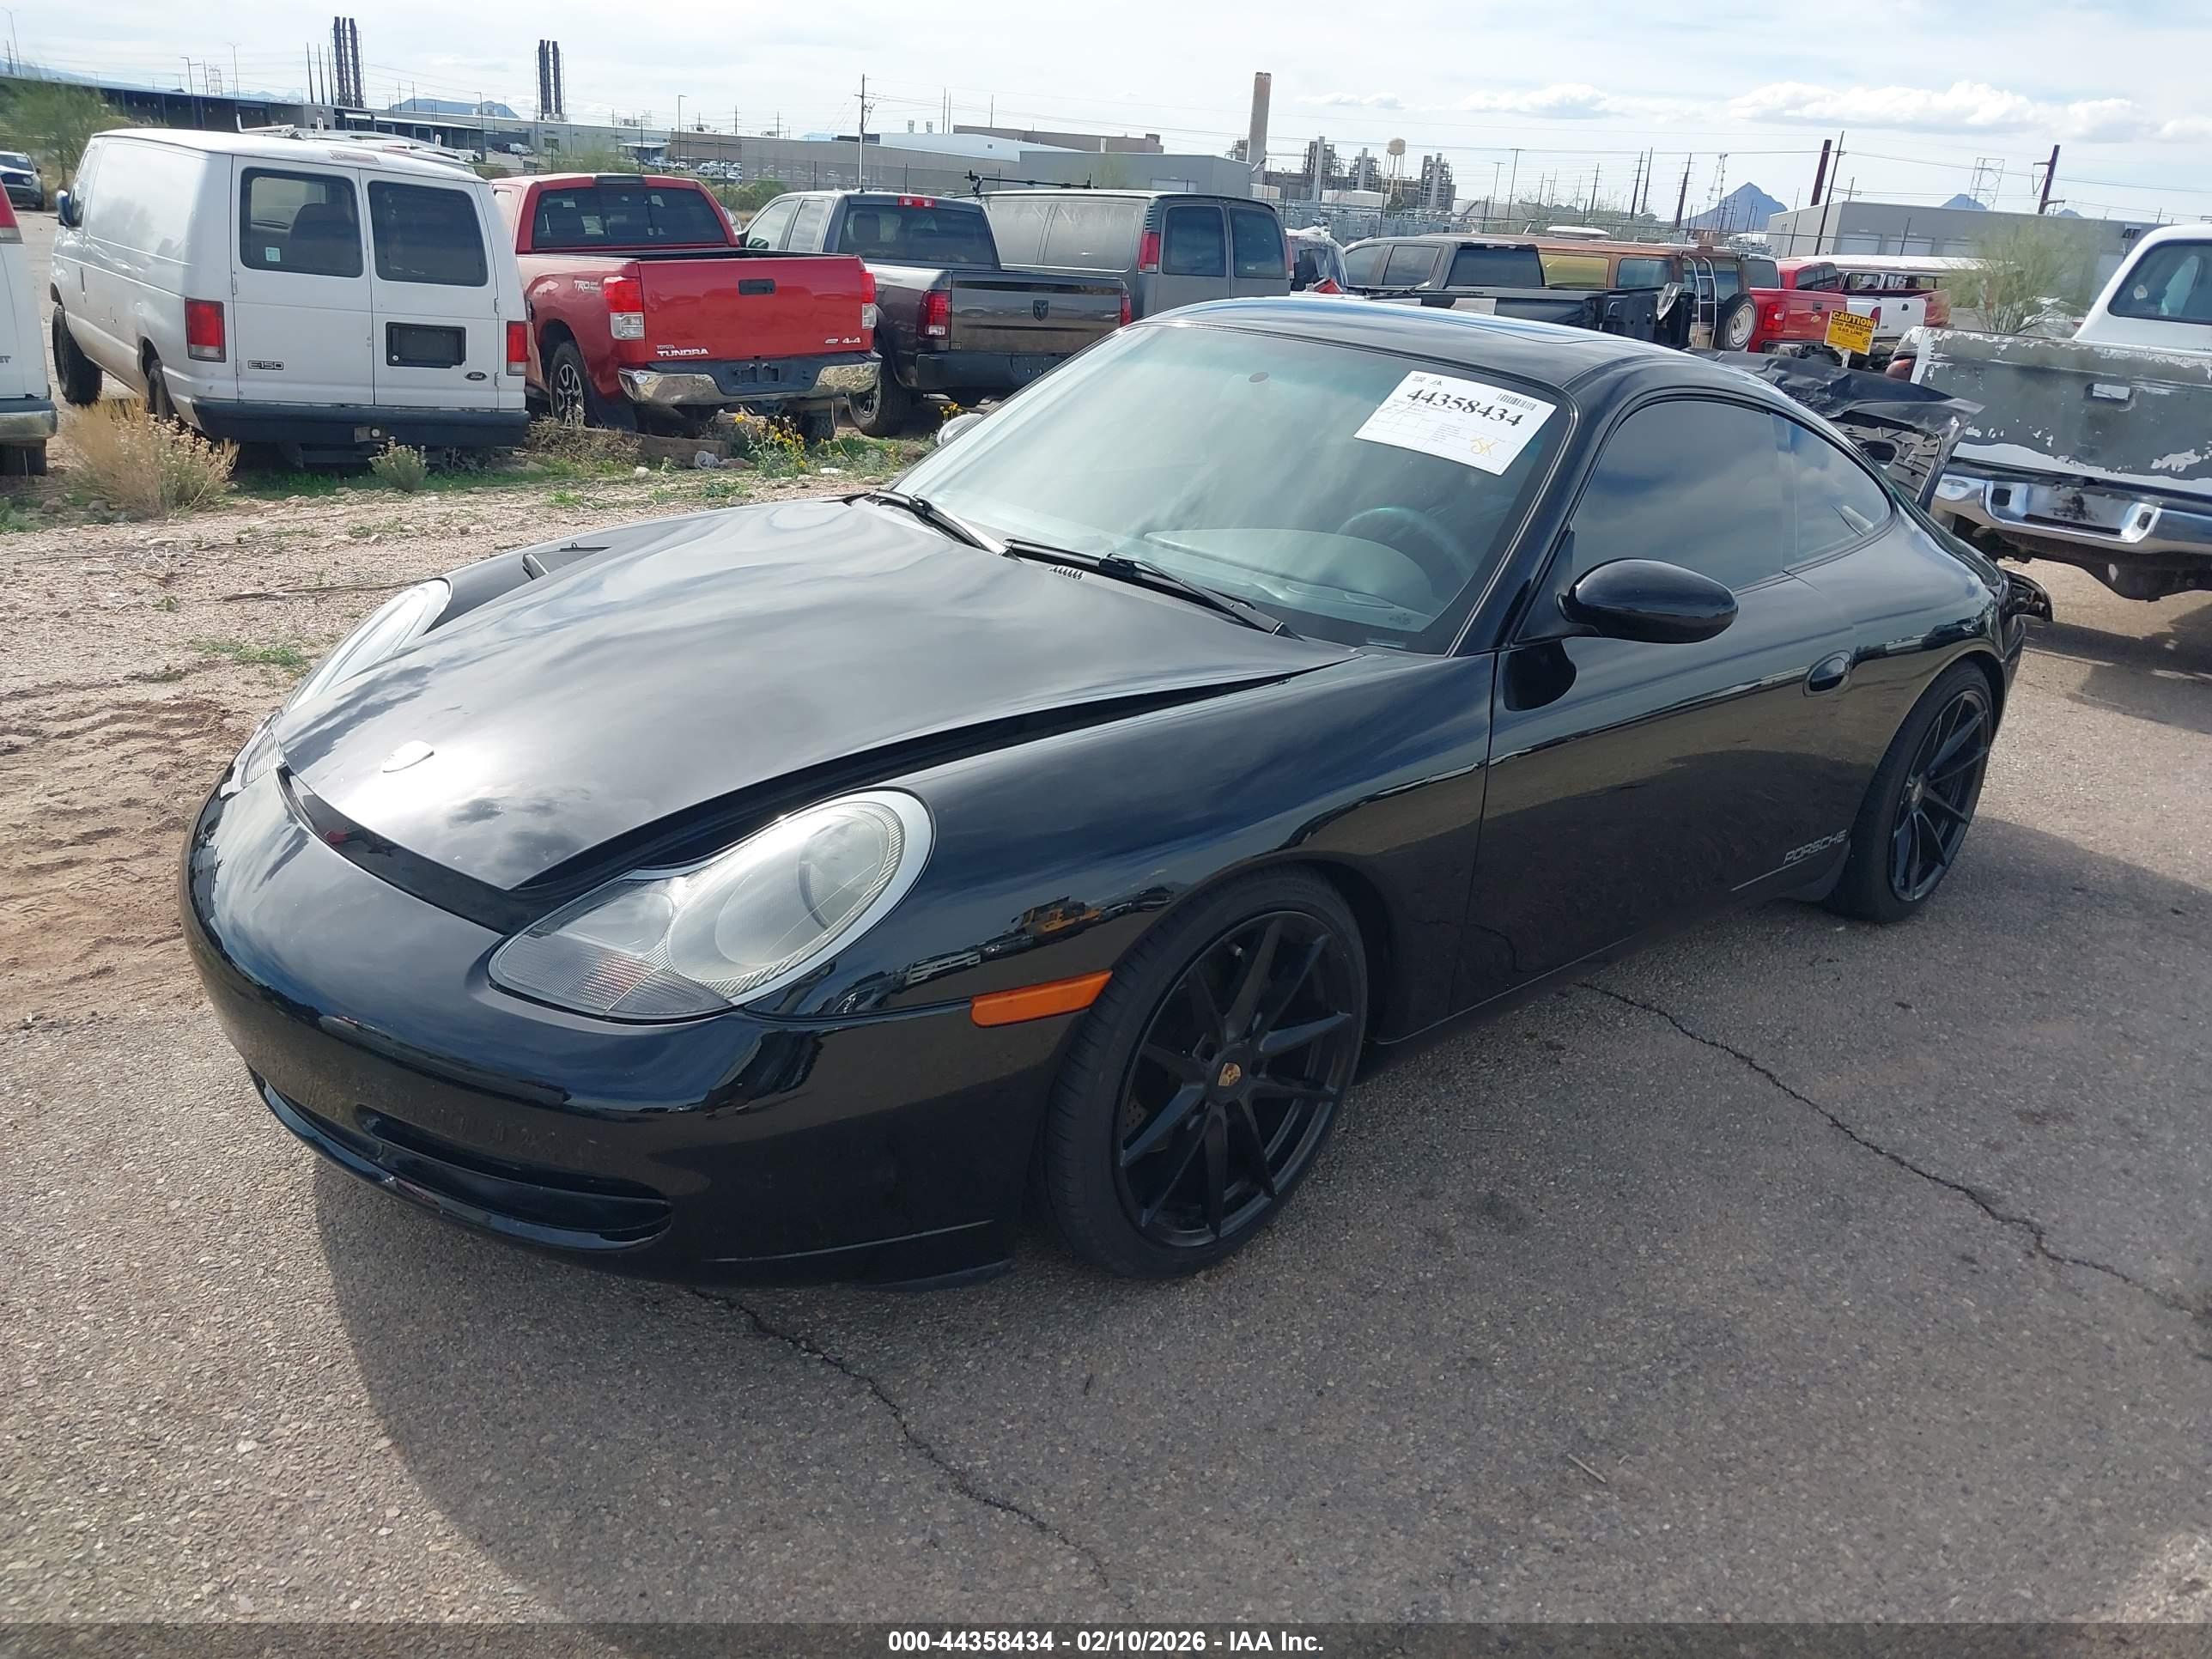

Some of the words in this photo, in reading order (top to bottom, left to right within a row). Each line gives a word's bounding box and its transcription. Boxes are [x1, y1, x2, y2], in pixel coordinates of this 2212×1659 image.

[574, 280, 590, 292] TRD
[1832, 312, 1874, 327] CAUTION
[1844, 324, 1872, 333] PRESSURE
[1407, 388, 1524, 427] 44358434
[1783, 829, 1847, 865] PORSCHE
